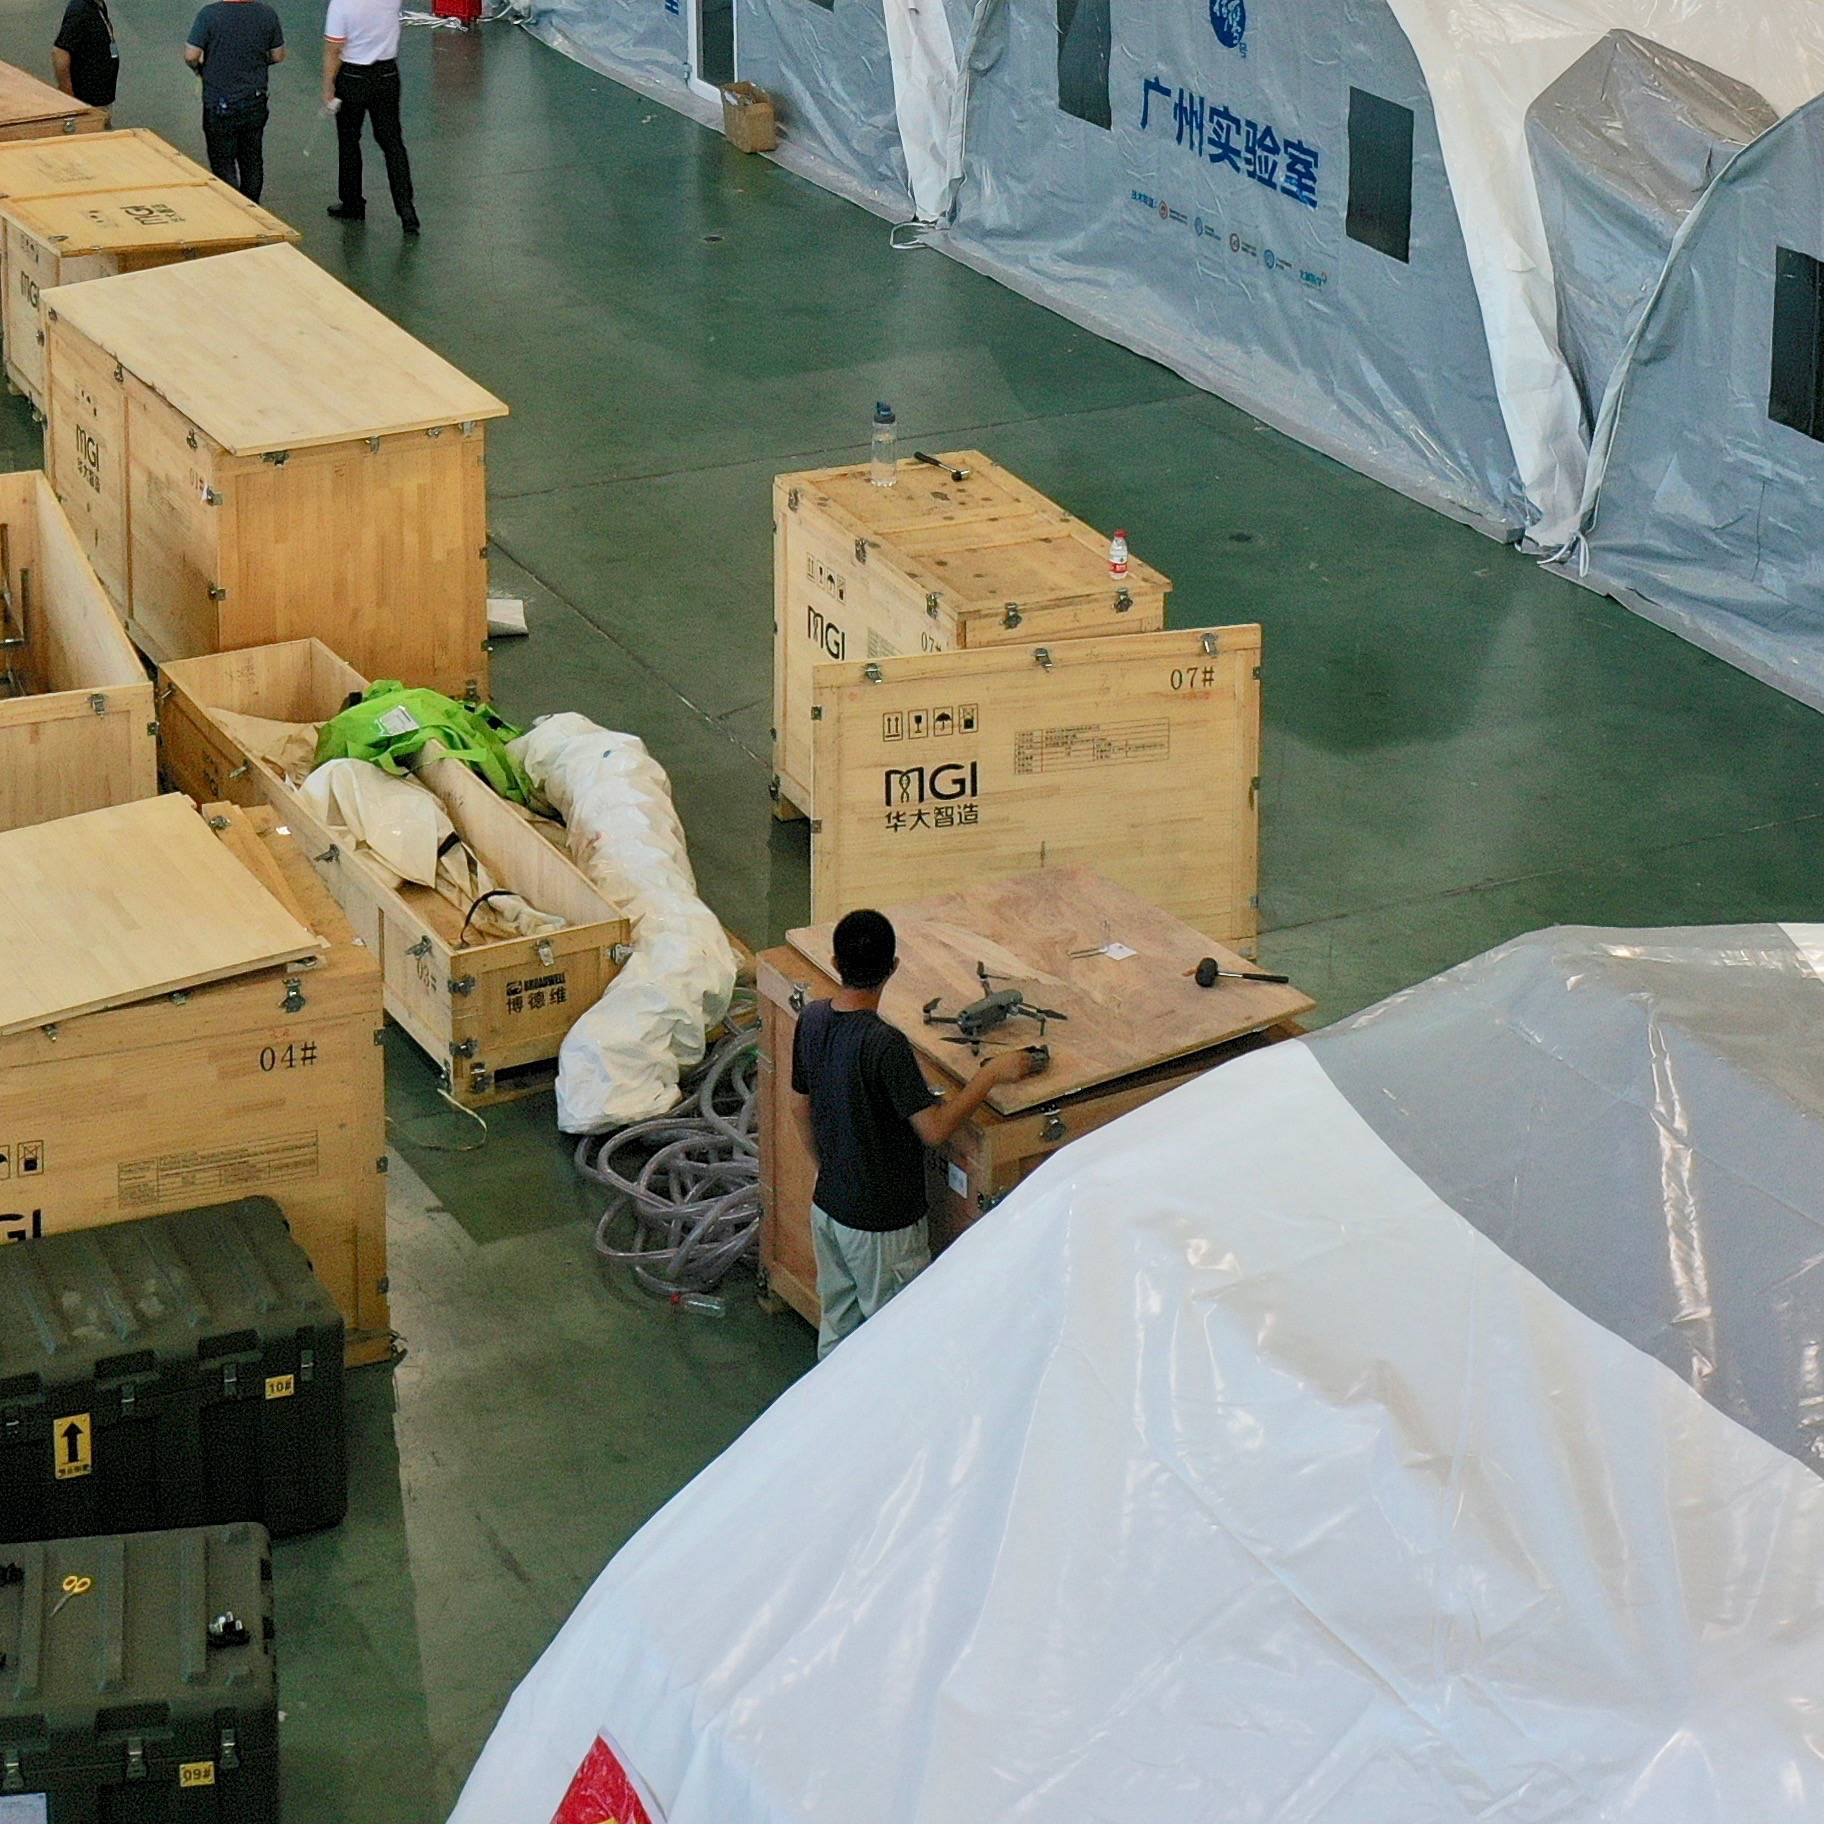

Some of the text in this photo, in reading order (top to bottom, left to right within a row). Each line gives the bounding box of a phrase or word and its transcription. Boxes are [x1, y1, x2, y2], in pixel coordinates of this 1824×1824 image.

[1140, 76, 1321, 209] 广州实验室
[77, 424, 99, 472] MGI
[807, 605, 846, 662] MGI
[1170, 665, 1216, 690] 07#
[884, 760, 978, 807] MGI
[885, 803, 979, 833] 华大智造
[506, 987, 568, 1015] 博德维
[259, 1040, 318, 1072] 04#
[268, 1380, 292, 1393] 10#
[183, 1768, 212, 1781] 09#
